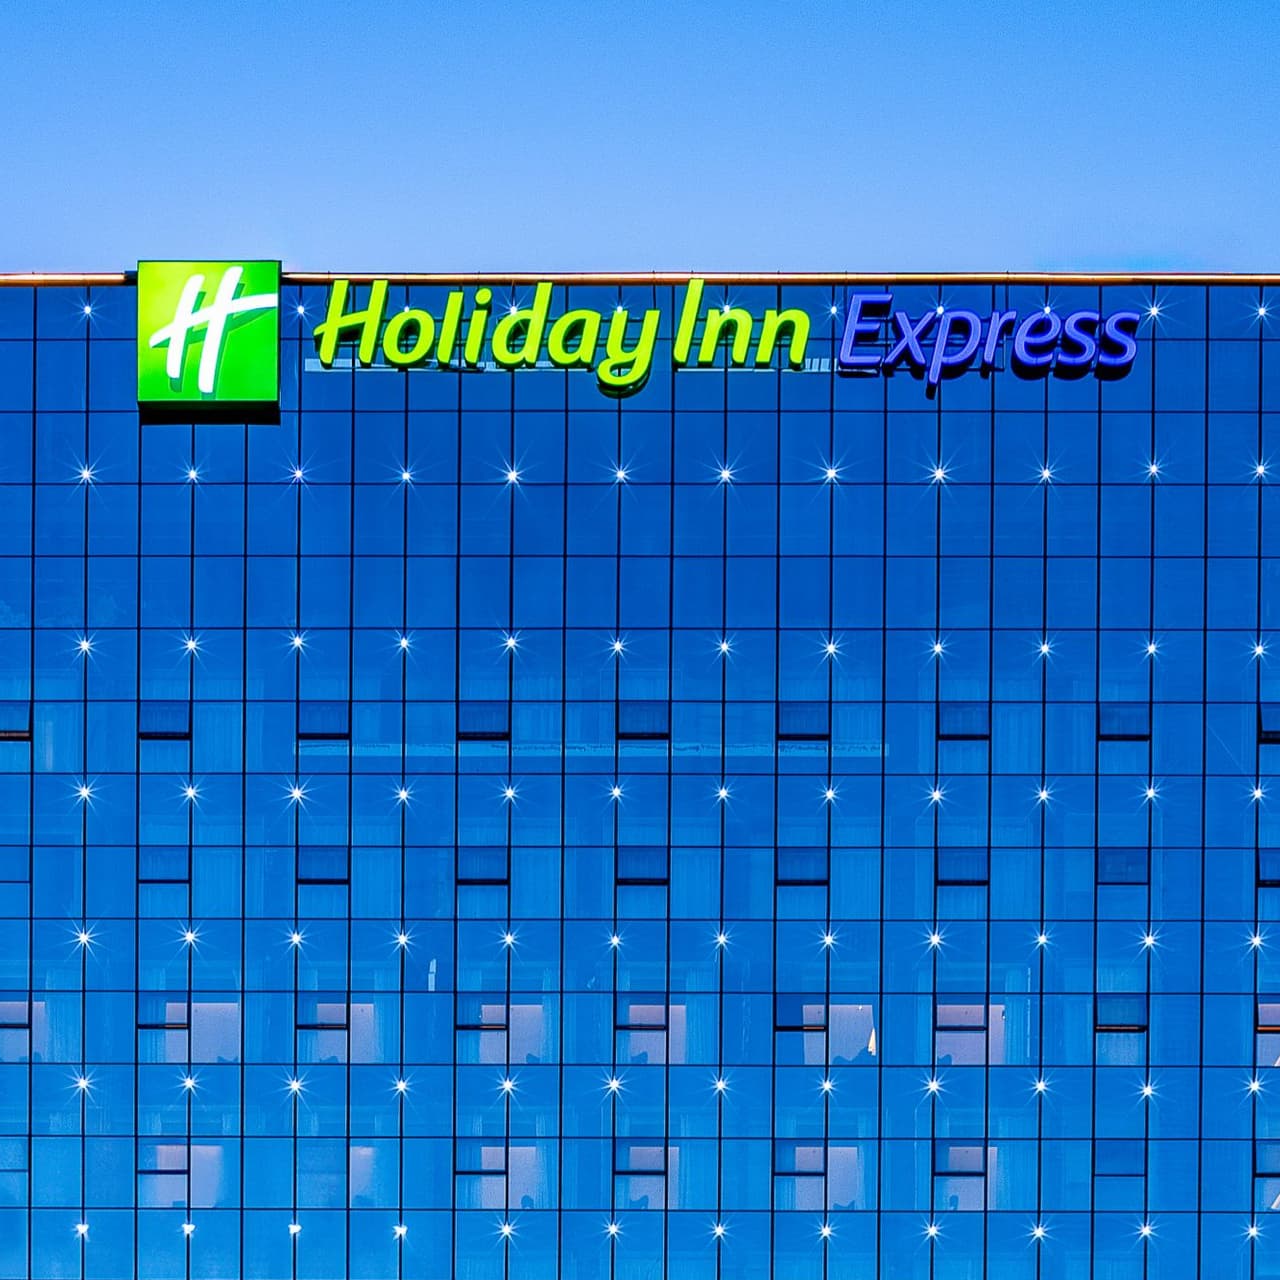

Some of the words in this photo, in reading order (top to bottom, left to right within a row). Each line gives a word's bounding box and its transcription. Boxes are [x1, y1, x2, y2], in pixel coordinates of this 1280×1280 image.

[313, 279, 661, 386] Holiday
[673, 278, 811, 365] Inn
[837, 292, 1142, 387] Express
